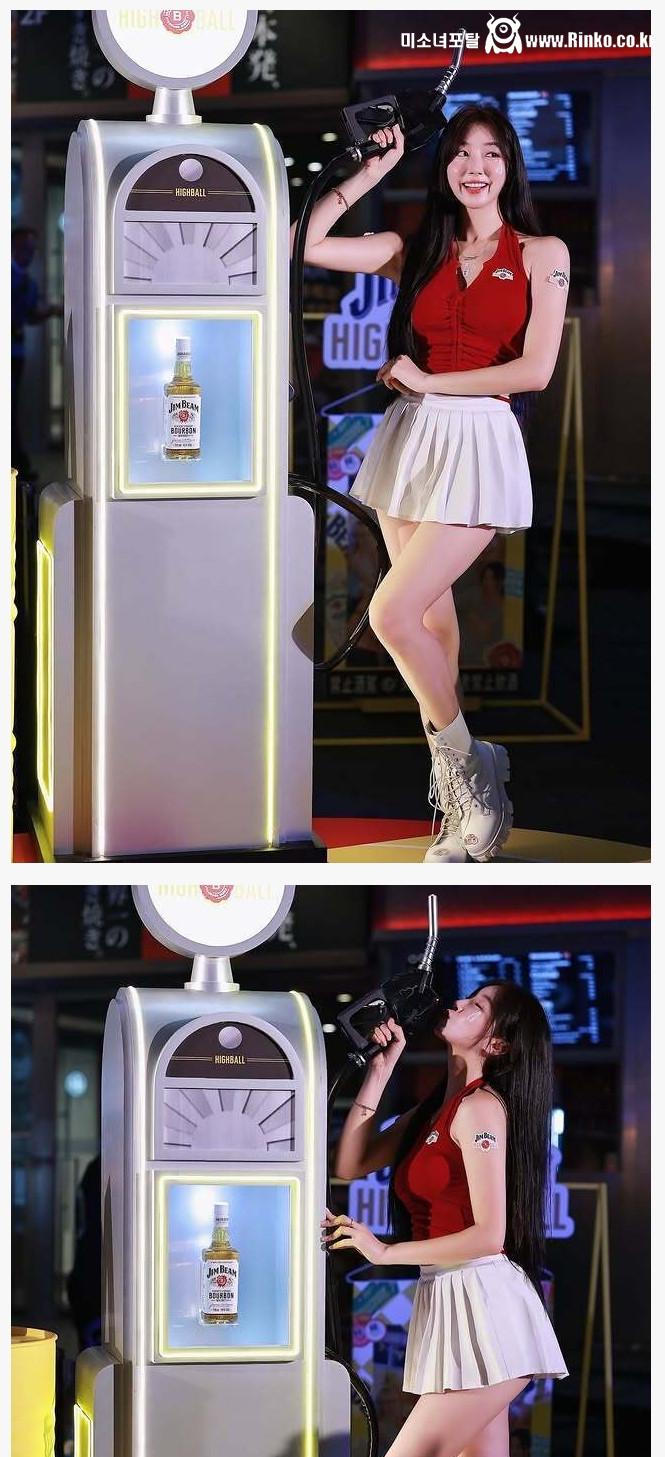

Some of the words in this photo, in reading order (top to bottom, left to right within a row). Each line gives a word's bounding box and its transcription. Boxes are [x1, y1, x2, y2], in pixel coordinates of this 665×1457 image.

[175, 187, 206, 197] HIGHBALL
[168, 402, 181, 414] JIM
[181, 399, 199, 413] BEAM
[170, 427, 197, 435] BOURBON
[214, 1055, 246, 1065] HIGHBALL
[207, 1267, 220, 1279] JIM
[220, 1264, 237, 1278] BEAM
[208, 1292, 235, 1300] BOURBON
